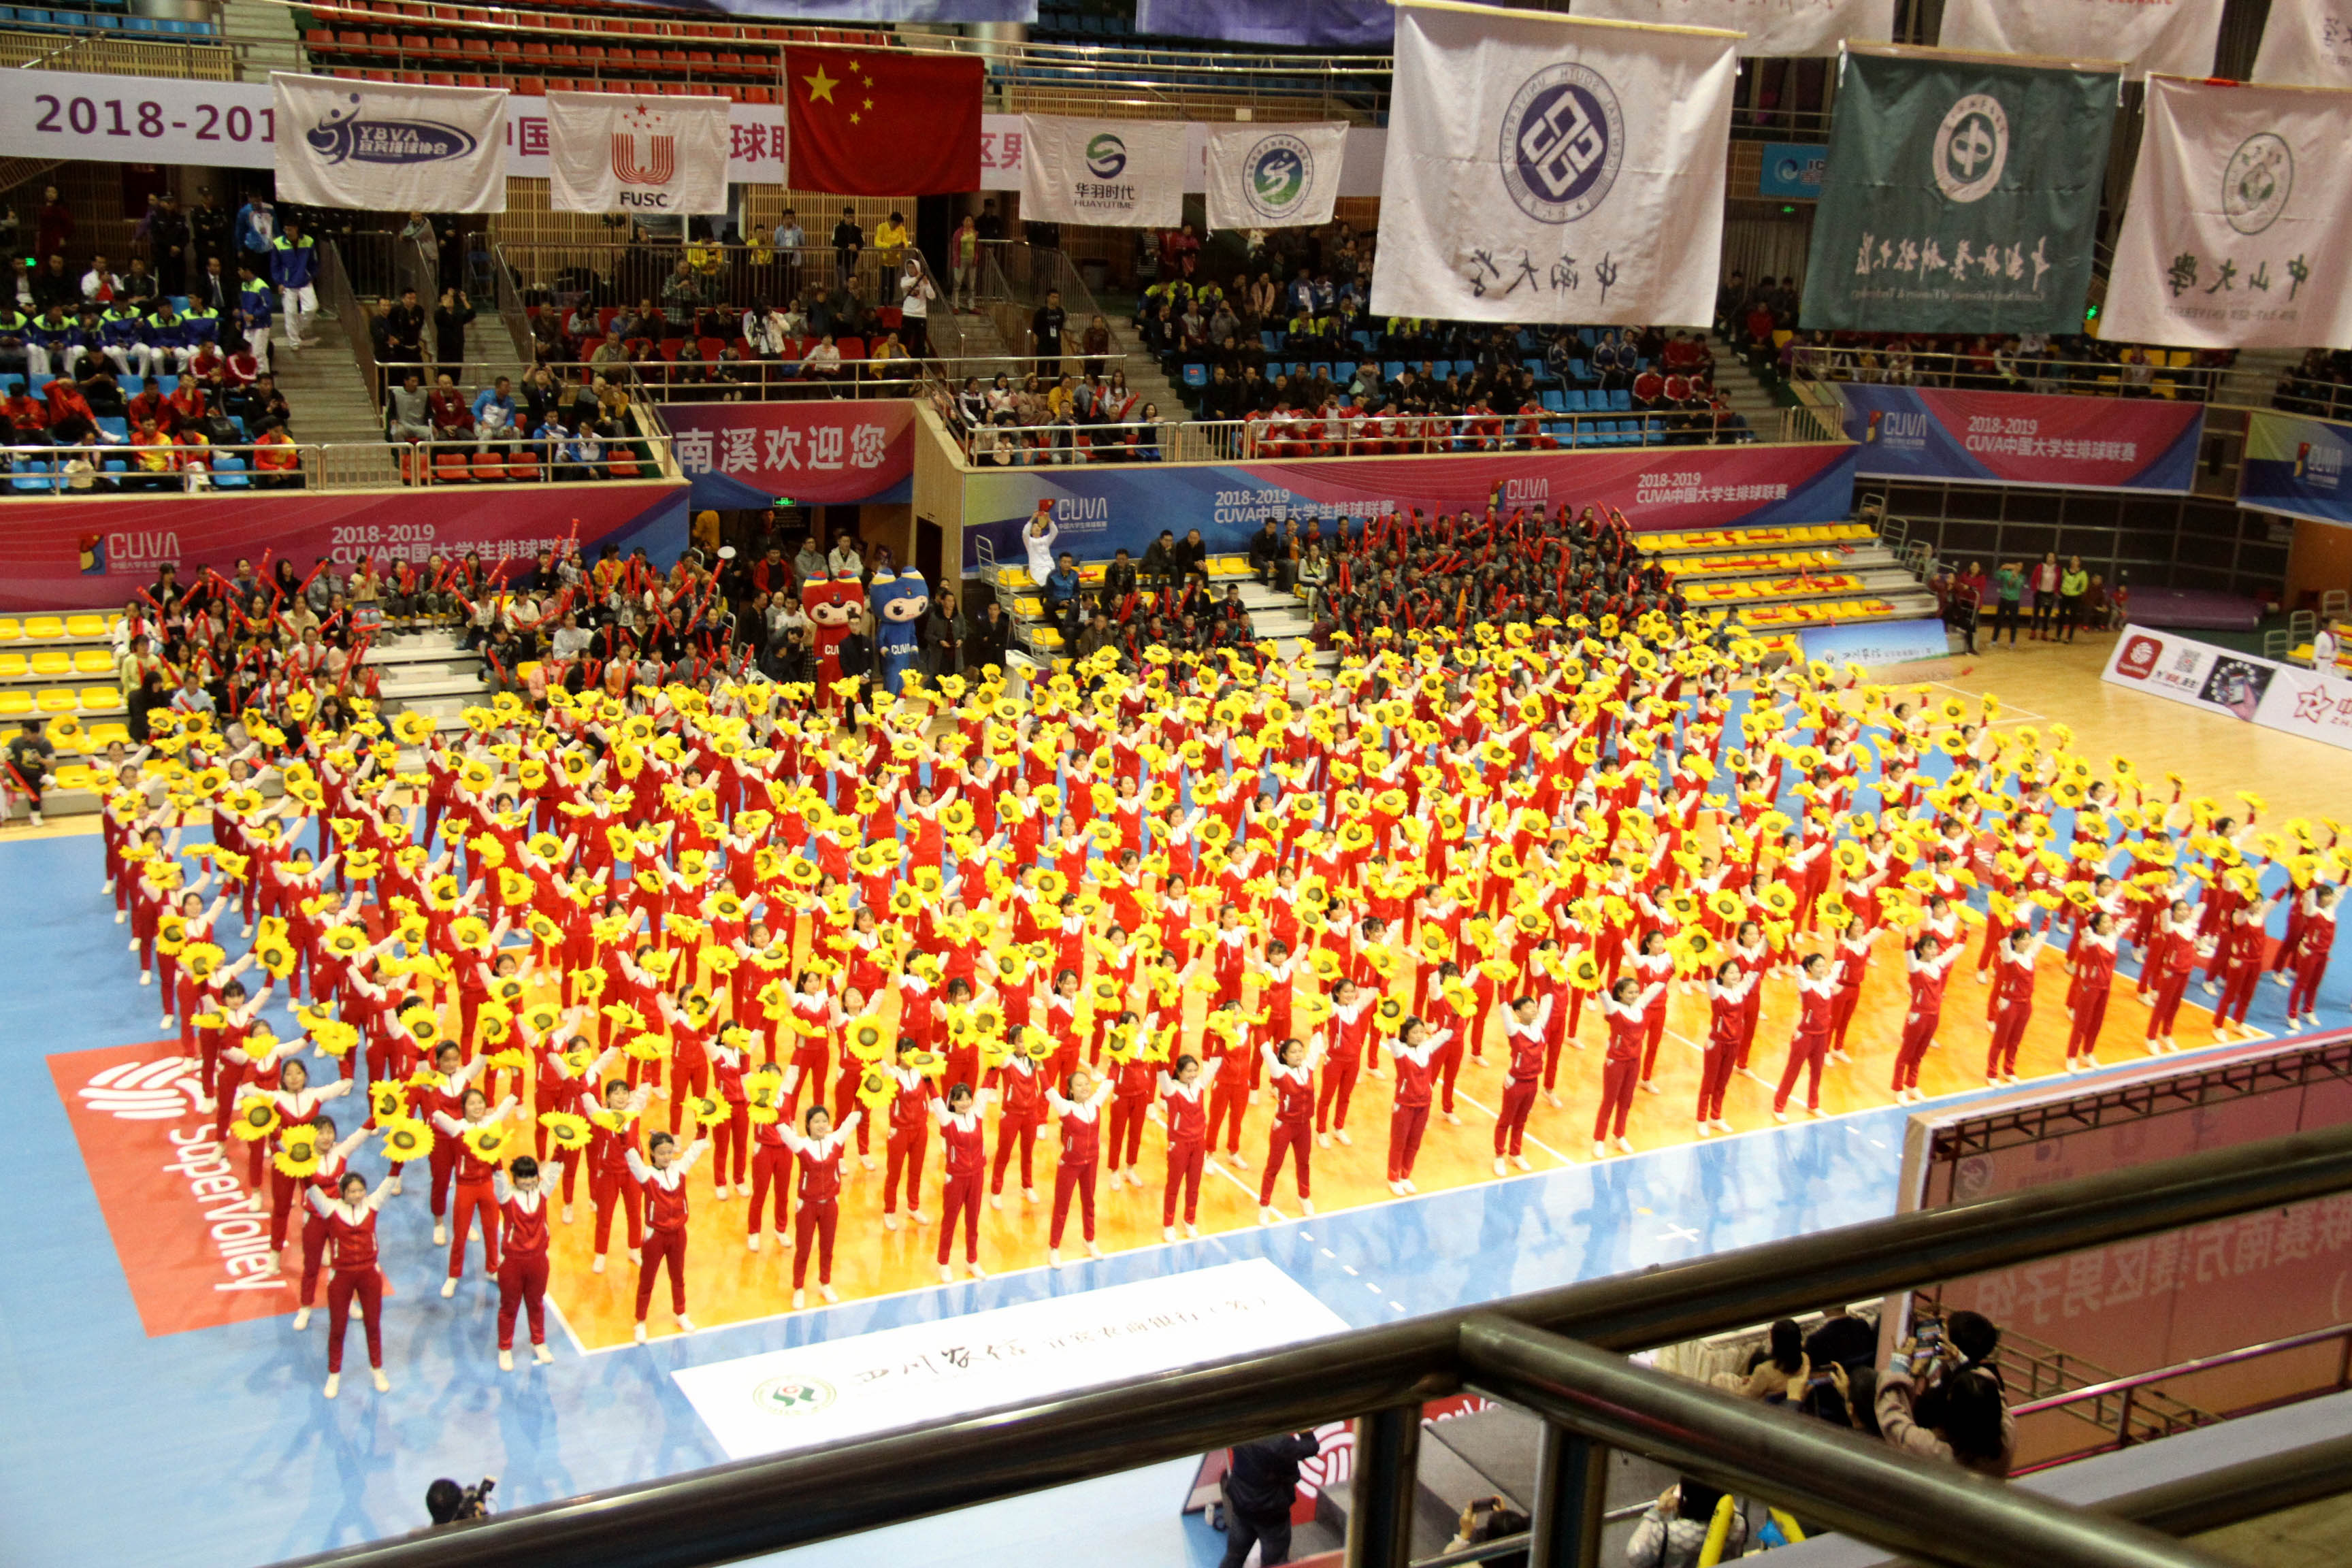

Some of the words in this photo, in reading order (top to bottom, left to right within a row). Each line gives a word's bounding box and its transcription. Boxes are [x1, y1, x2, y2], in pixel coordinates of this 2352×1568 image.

[360, 126, 420, 142] YBVA
[619, 191, 668, 208] FUSC
[1075, 182, 1134, 200] 华羽时代
[1074, 199, 1134, 210] HUAYUTIME
[1884, 412, 1927, 437] CUVA
[1968, 416, 2038, 435] 2018-2019
[675, 423, 886, 474] 南溪欢迎您
[1507, 478, 1548, 500] CUVA
[1637, 472, 1701, 489] 2018-2019
[1215, 489, 1290, 507] 2018-2019
[1636, 483, 1788, 504] CUVA中国大学生排球联赛
[1058, 497, 1108, 521] CUVA
[1214, 500, 1395, 524] CUVA中国大学生排球联赛
[331, 523, 436, 544] 2018-2019
[109, 532, 181, 559] CUVA
